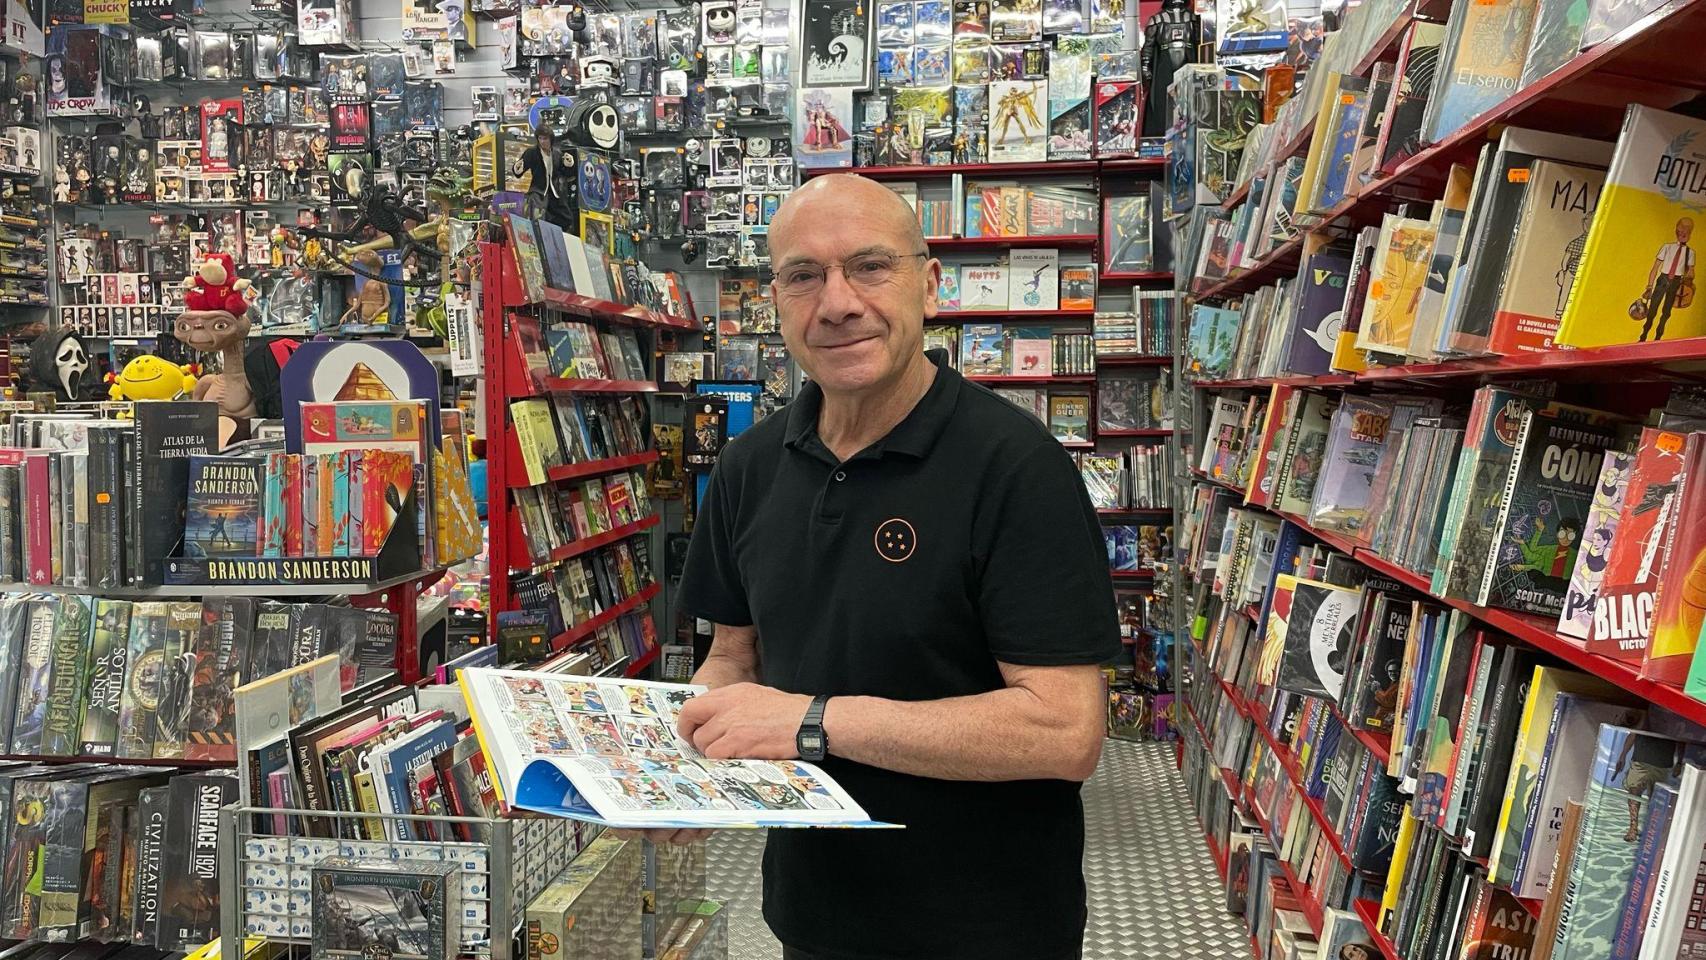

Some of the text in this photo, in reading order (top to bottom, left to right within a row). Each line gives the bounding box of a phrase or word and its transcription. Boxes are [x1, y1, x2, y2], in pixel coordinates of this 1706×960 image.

[86, 3, 127, 14] CHUCKY
[12, 22, 26, 39] IT
[1457, 67, 1474, 86] El
[48, 98, 96, 111] THE CROW
[1551, 179, 1603, 214] MA
[968, 270, 1001, 281] MUTTS
[163, 435, 205, 447] ATLAS DE LA
[159, 446, 209, 458] TIERRA MEDIA
[203, 465, 255, 480] BRANDON
[195, 479, 259, 496] SANDERSON
[208, 560, 371, 580] BRANDON SANDERSON
[1516, 588, 1544, 605] SCOTT
[1316, 617, 1325, 625] 8
[1321, 603, 1336, 645] MENTIRAS
[1327, 601, 1342, 648] SUPERREALES
[1595, 590, 1657, 642] BLAC
[29, 615, 43, 660] HORROR
[107, 646, 127, 715] ANILLOS
[144, 825, 151, 836] UN
[194, 784, 222, 880] SCARFACE 1920
[145, 812, 163, 923] CIVILIZATION
[1551, 851, 1560, 871] BOY
[1474, 888, 1484, 919] ASIMOV
[1650, 869, 1671, 929] VIVIAN MAIER
[1491, 907, 1538, 936] ASI
[1556, 881, 1578, 945] TUNGSTENO
